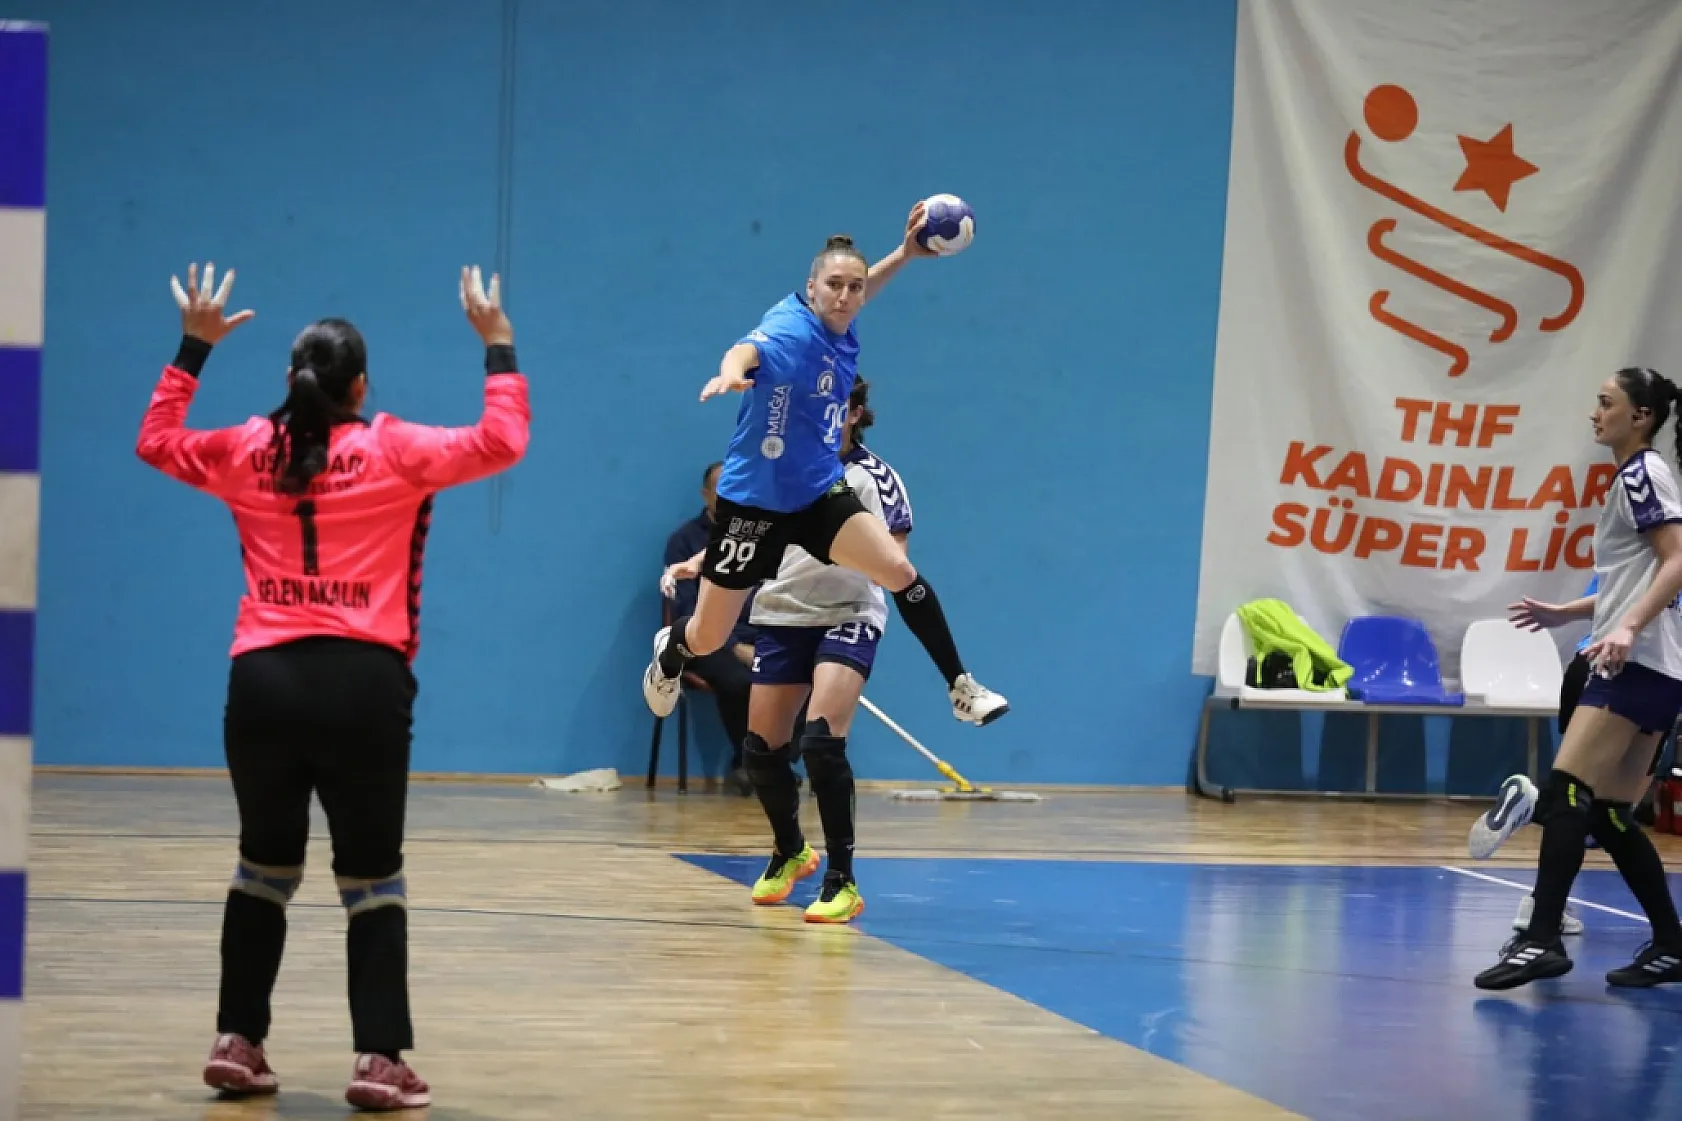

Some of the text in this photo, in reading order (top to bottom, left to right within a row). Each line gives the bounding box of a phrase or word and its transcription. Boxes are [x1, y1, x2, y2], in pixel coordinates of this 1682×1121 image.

[1395, 397, 1521, 448] THF
[252, 449, 364, 474] USAR
[1279, 441, 1618, 511] KADINLAR
[293, 500, 320, 577] 1
[715, 539, 756, 575] 29
[1266, 496, 1597, 572] SÜPER LİG
